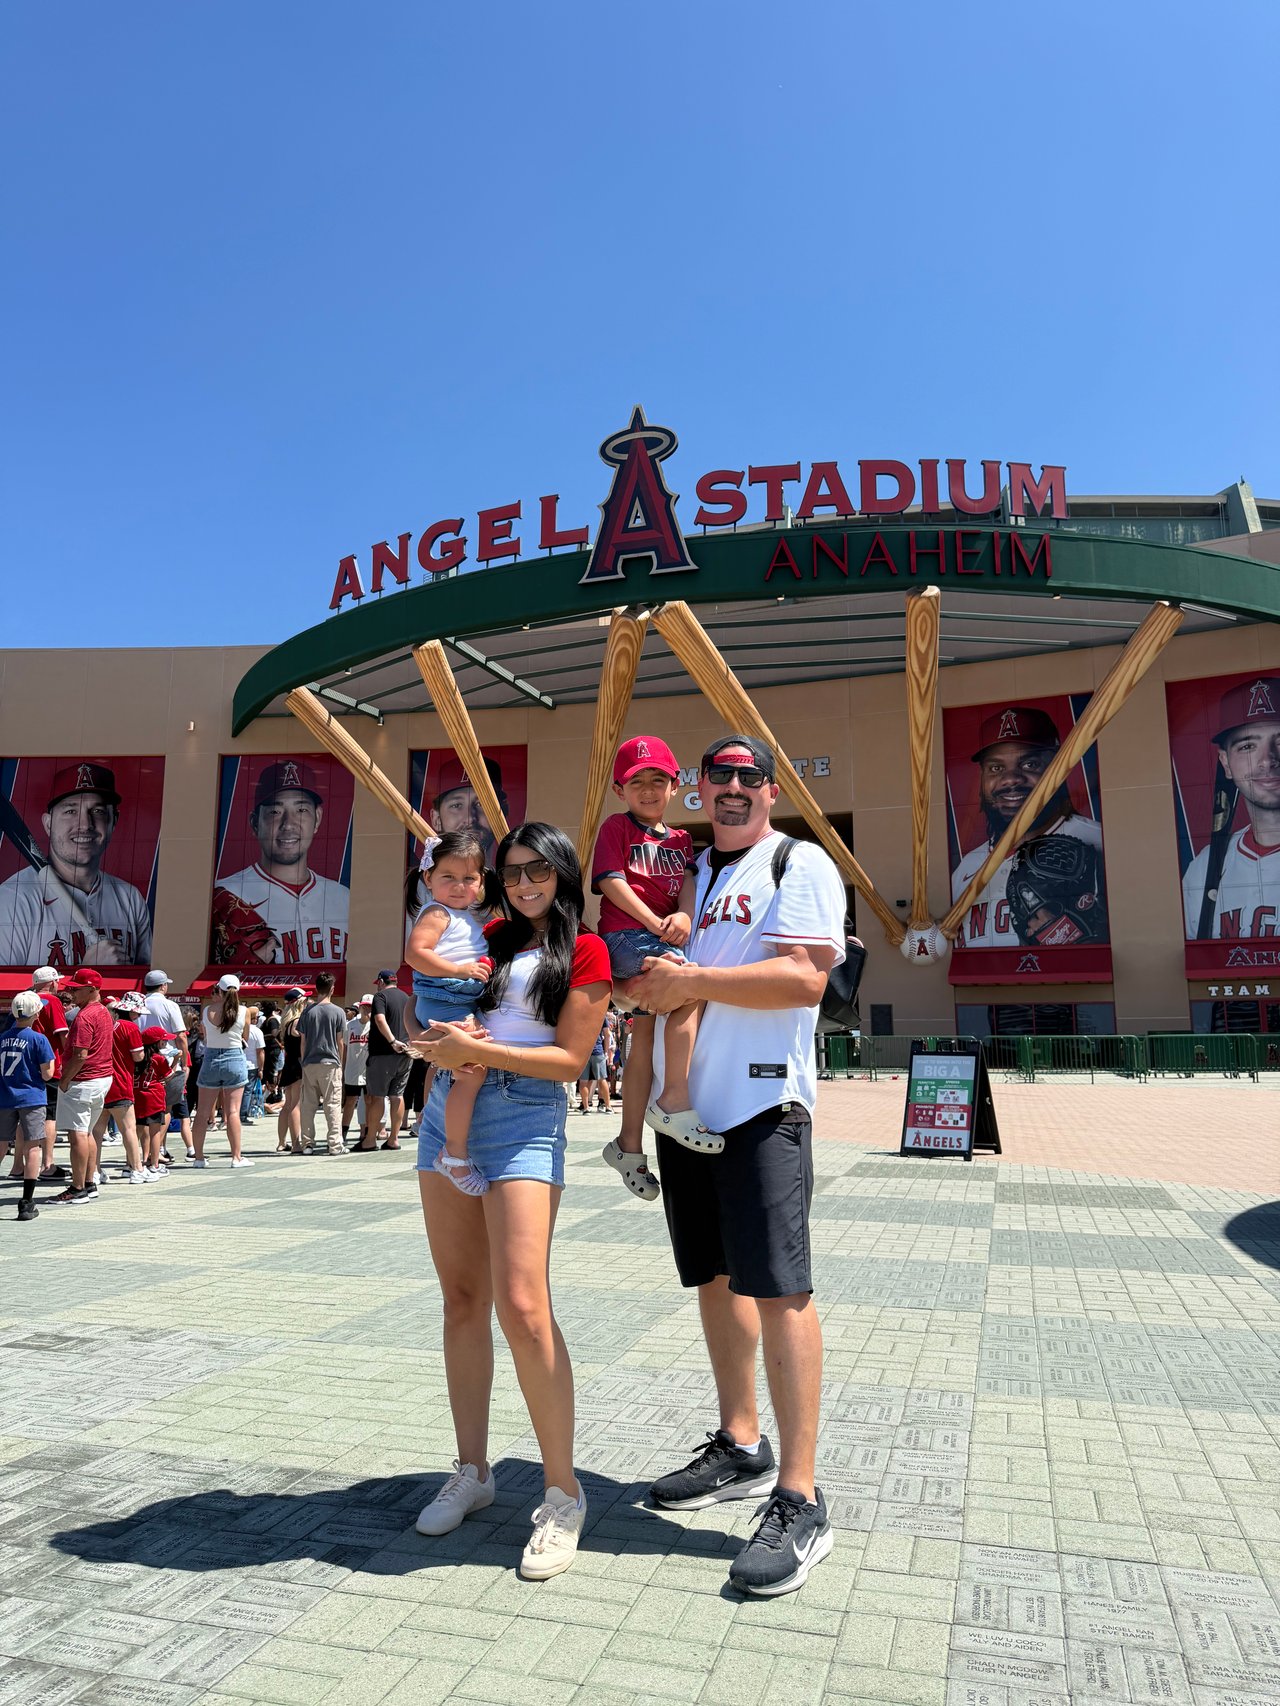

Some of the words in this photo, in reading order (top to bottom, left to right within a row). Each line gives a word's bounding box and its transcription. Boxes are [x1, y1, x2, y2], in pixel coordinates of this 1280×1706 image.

[695, 459, 1069, 527] STADIUM
[329, 494, 590, 610] ANGEL
[765, 530, 1052, 581] ANAHEIM
[1208, 985, 1271, 997] TEAM
[923, 1065, 946, 1077] BIG
[950, 1066, 961, 1077] A
[912, 1130, 963, 1149] ANGELS
